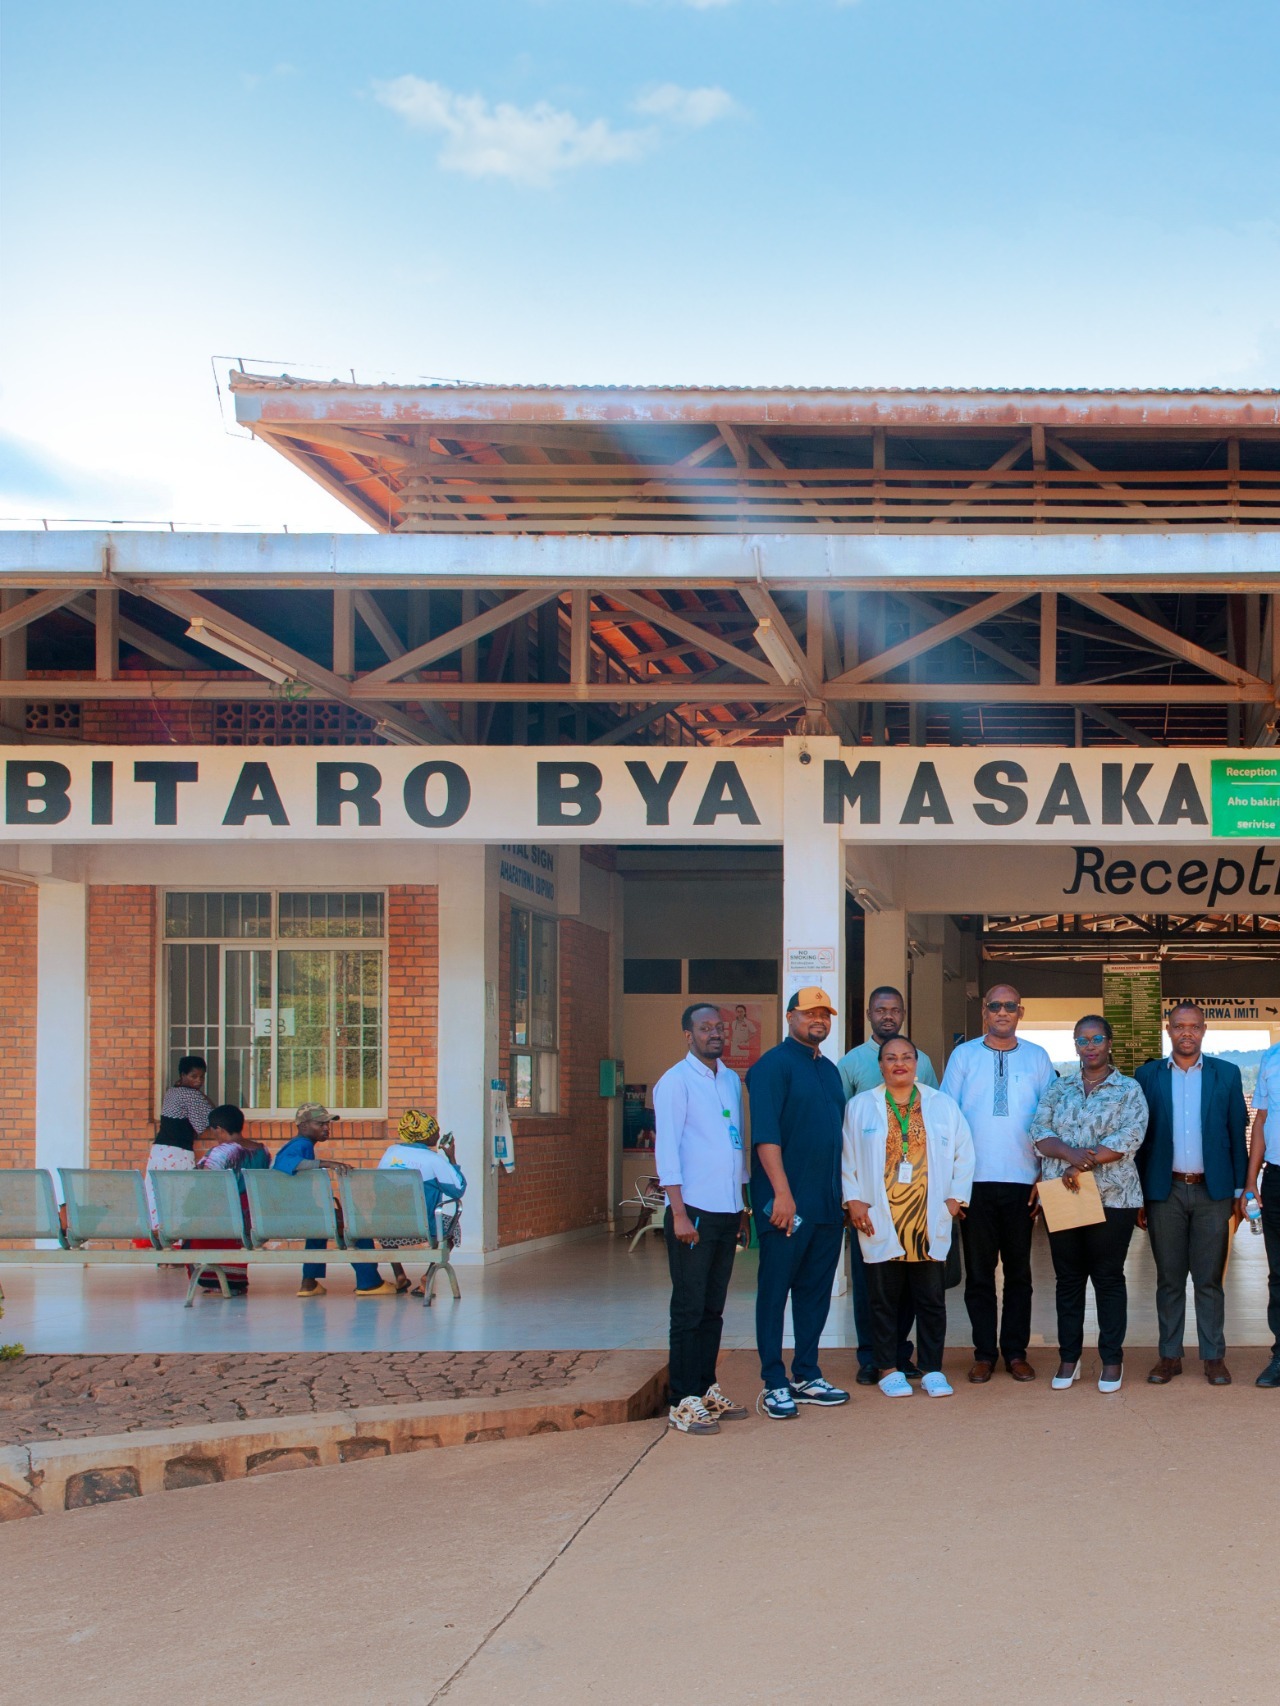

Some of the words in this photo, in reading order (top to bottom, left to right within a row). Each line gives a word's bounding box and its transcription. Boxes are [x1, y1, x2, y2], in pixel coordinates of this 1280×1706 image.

[1226, 766, 1277, 778] Reception
[6, 760, 471, 828] BITARO
[537, 760, 761, 826] BYA
[823, 760, 1209, 826] MASAKA
[1227, 797, 1248, 806] Aho
[1237, 820, 1276, 829] serivise
[531, 845, 554, 872] SIGN
[1234, 1008, 1259, 1019] IMITI
